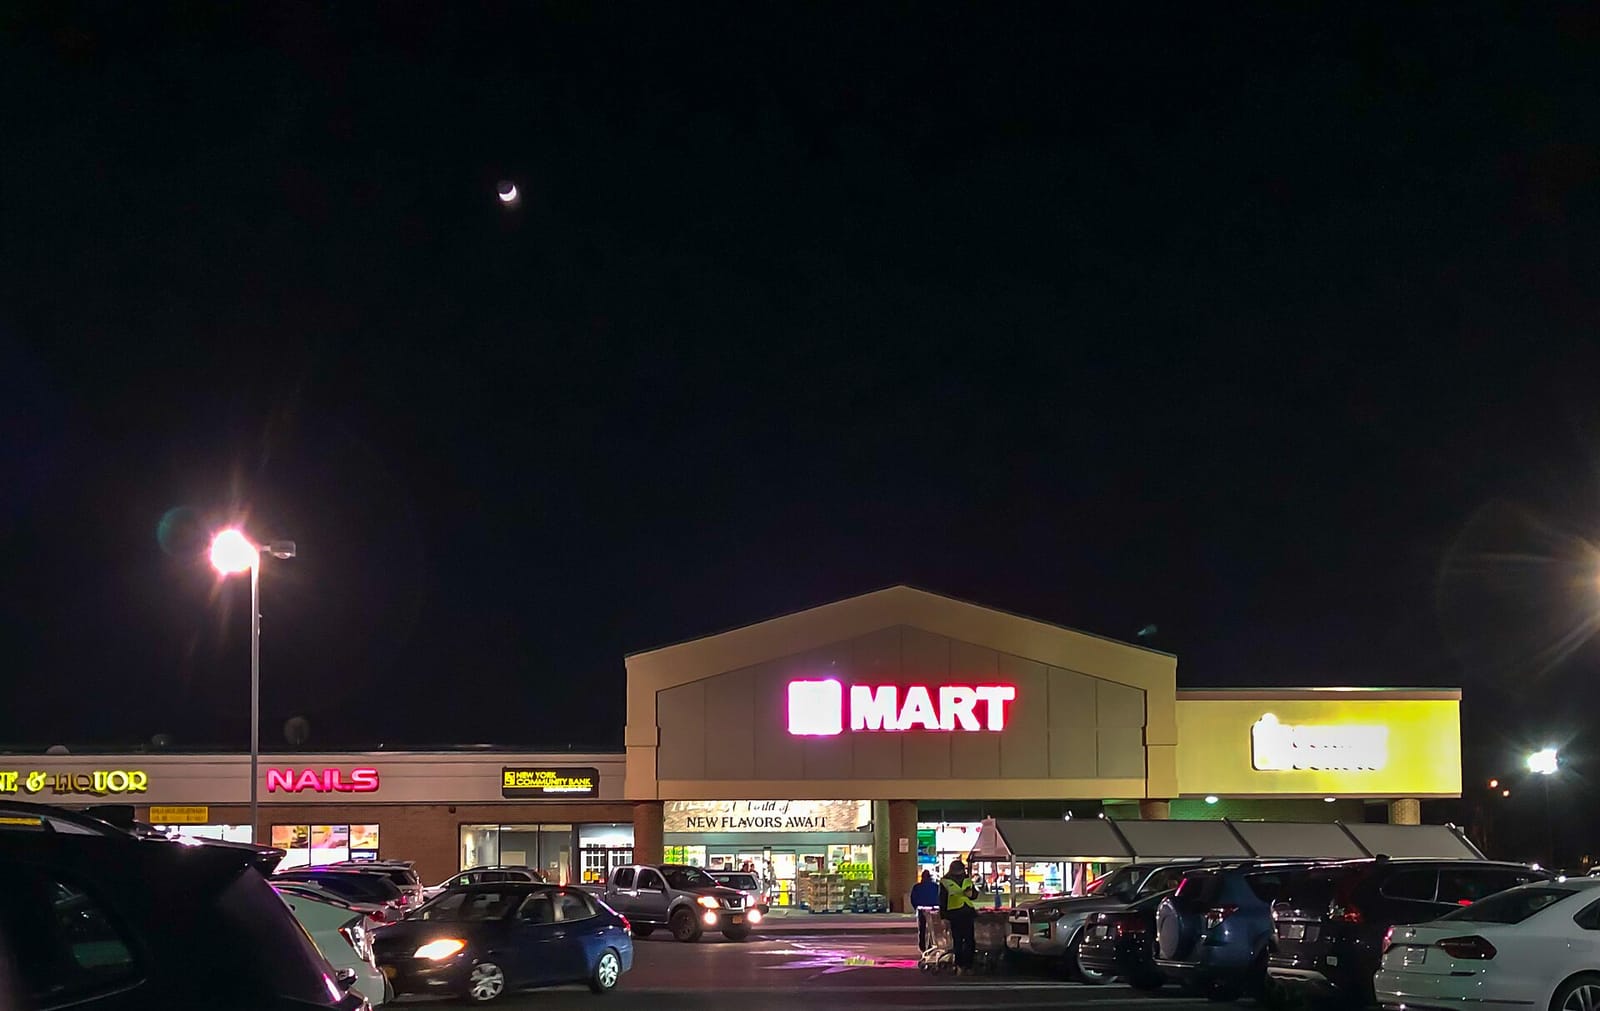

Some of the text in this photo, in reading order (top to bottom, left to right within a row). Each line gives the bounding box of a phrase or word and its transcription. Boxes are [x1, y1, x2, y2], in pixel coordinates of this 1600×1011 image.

[850, 685, 1016, 732] MART
[25, 770, 47, 792] &
[54, 770, 148, 796] LIQUOR
[266, 767, 380, 793] NAILS
[516, 771, 557, 779] NEW YORK
[516, 778, 591, 786] COMMUNITY BANK
[686, 816, 828, 829] NEW FLAVORS AWAIT
